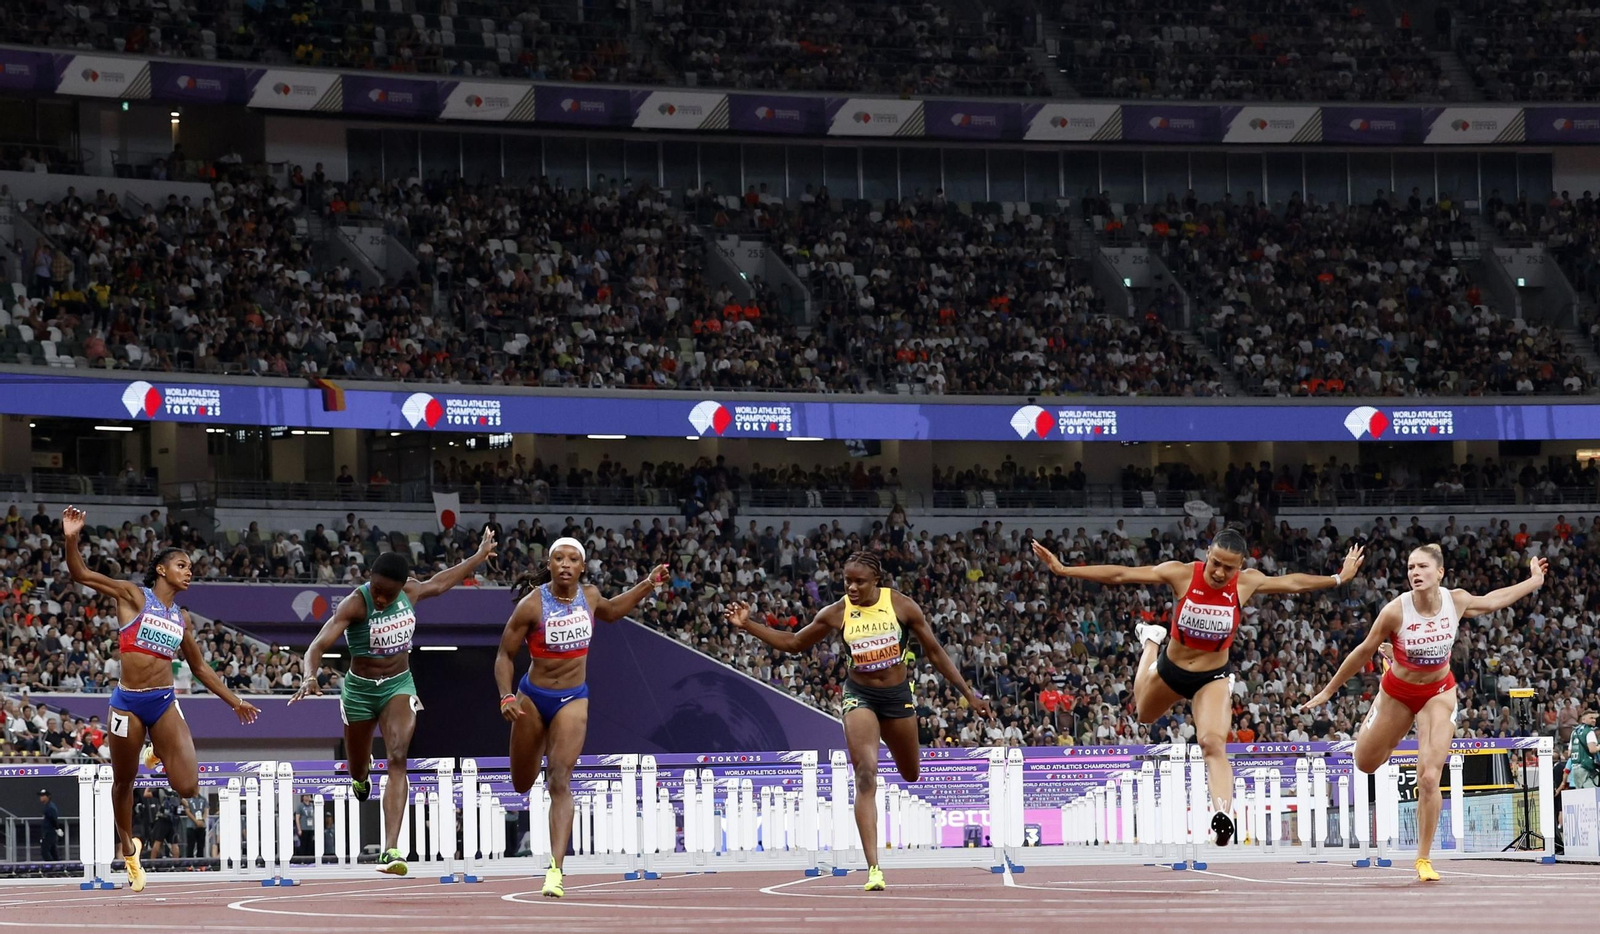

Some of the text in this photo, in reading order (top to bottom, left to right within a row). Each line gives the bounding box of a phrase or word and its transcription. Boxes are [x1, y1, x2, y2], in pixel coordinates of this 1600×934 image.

[369, 236, 386, 245] 256
[747, 250, 764, 258] 255
[1132, 255, 1149, 264] 254
[1526, 255, 1544, 264] 253
[165, 388, 220, 398] WORLD ATHLETICS
[165, 396, 220, 406] CHAMPIONSHIPS
[446, 399, 501, 408] WORLD ATHLETICS
[446, 407, 501, 416] CHAMPIONSHIPS
[1058, 410, 1081, 418] WORLD
[735, 414, 791, 423] CHAMPIONSHIPS
[1058, 418, 1116, 426] CHAMPIONSHIPS
[1392, 418, 1453, 426] CHAMPIONSHIPS
[1184, 603, 1231, 617] HONDA
[143, 617, 182, 635] HONDA
[372, 617, 414, 634] HONDA
[547, 615, 588, 627] HONDA
[1180, 613, 1231, 631] KAMBUNDJI
[850, 622, 896, 634] JAMAICA
[140, 627, 179, 649] RUSSELL
[550, 626, 590, 642] STARK
[1406, 633, 1452, 645] HONDA
[851, 636, 897, 650] HONDA
[853, 645, 898, 663] WILLIAMS
[114, 717, 122, 732] 7
